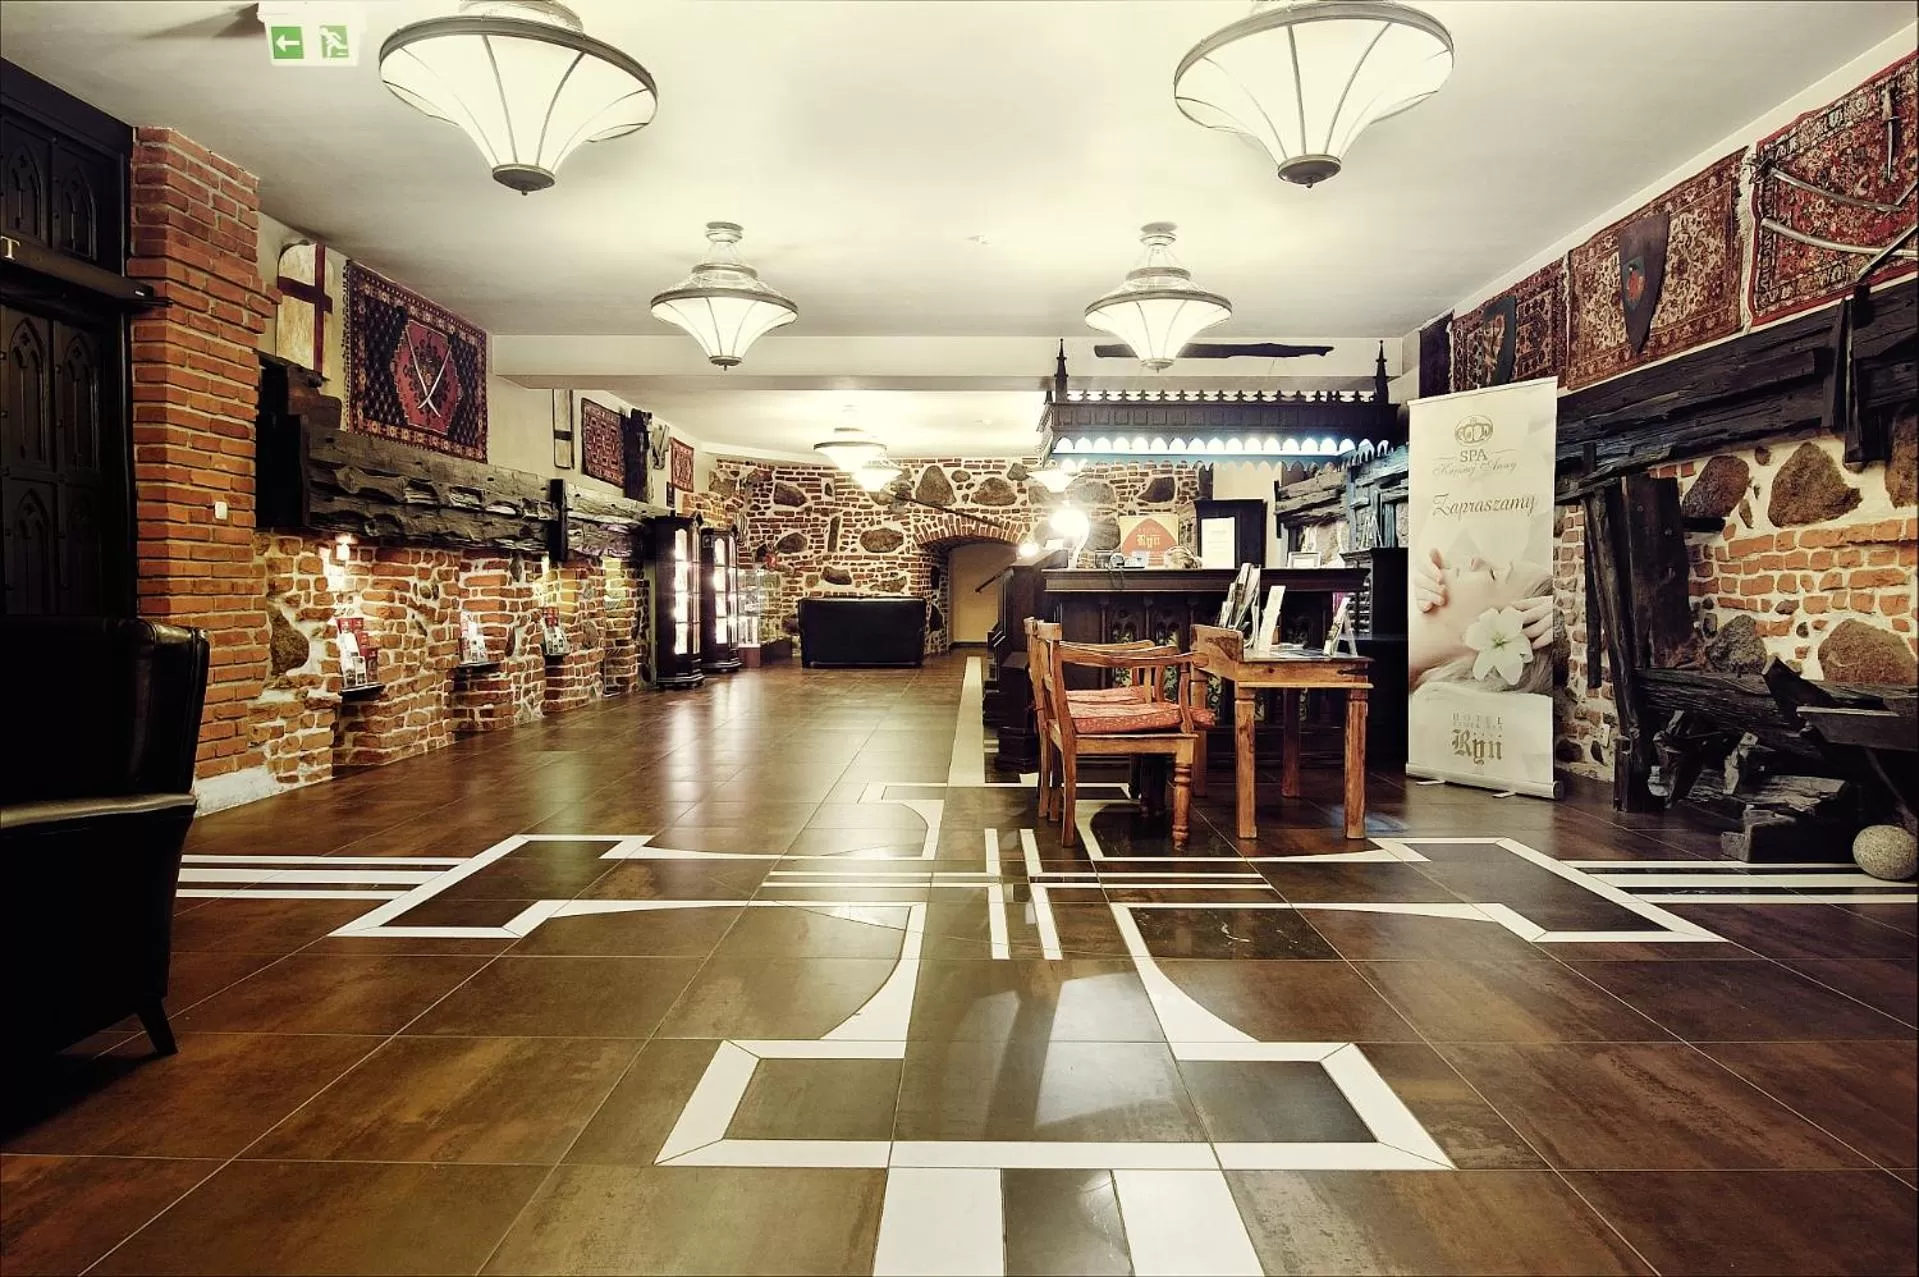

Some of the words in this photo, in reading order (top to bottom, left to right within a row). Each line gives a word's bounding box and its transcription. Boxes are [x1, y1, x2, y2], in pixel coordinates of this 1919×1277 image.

[1459, 448, 1489, 463] SPA
[1432, 493, 1536, 521] Zapraszamy
[1451, 728, 1503, 765] Ryn
